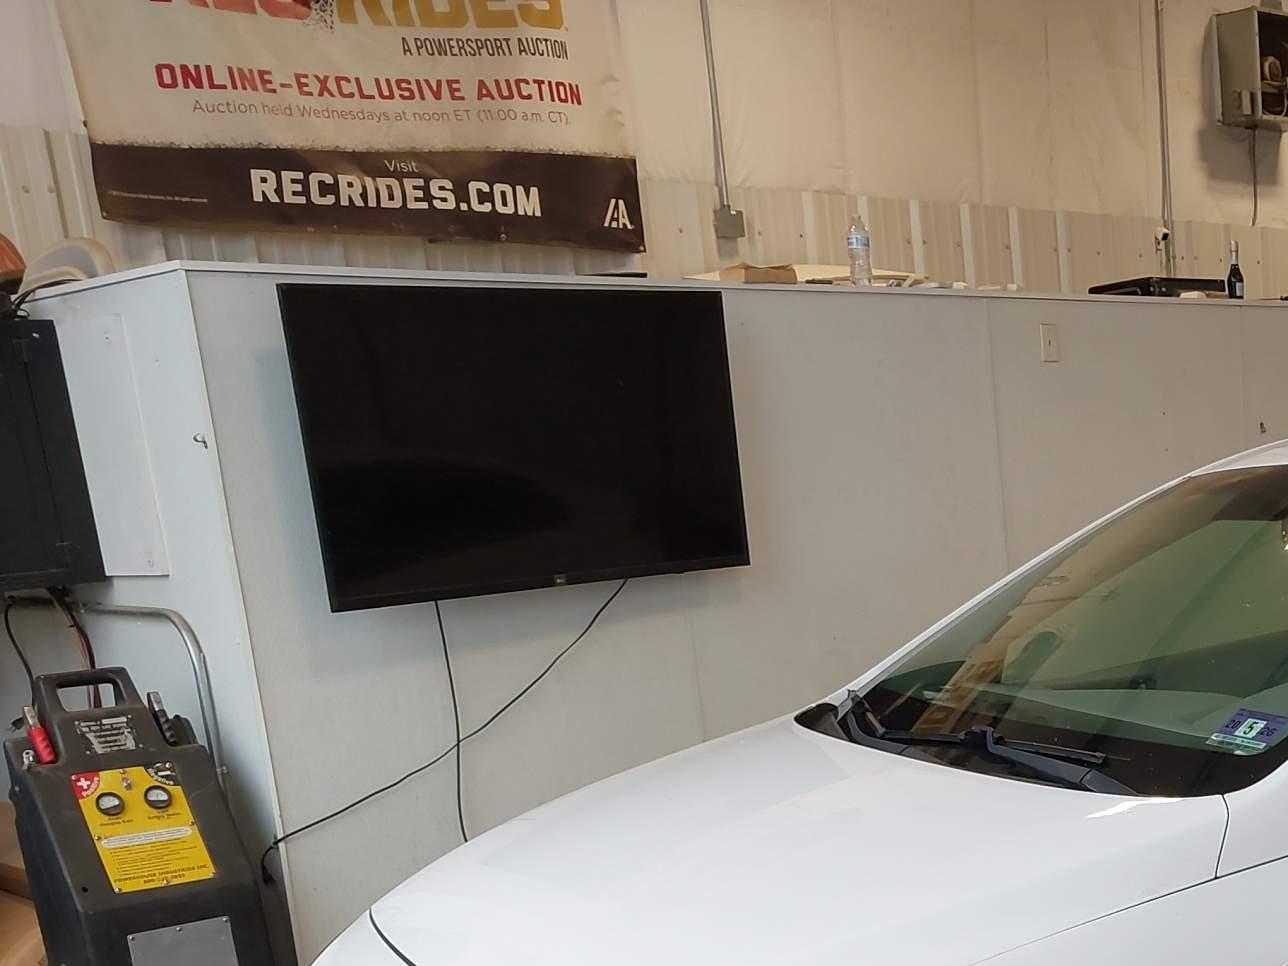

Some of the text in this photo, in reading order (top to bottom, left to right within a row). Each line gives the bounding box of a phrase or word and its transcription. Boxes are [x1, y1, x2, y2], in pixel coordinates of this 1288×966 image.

[401, 37, 569, 61] A POWERSPORT AUCTION
[155, 63, 582, 106] ONLINE-EXCLUSIVE AUCTION
[193, 100, 257, 114] Auction
[263, 103, 292, 117] held
[297, 104, 390, 122] Wednesdays
[394, 110, 407, 121] at
[414, 111, 449, 122] noon
[454, 110, 472, 121] ET
[384, 159, 418, 173] Visit
[250, 168, 542, 217] RECRIDES.COM
[1243, 721, 1258, 735] 5
